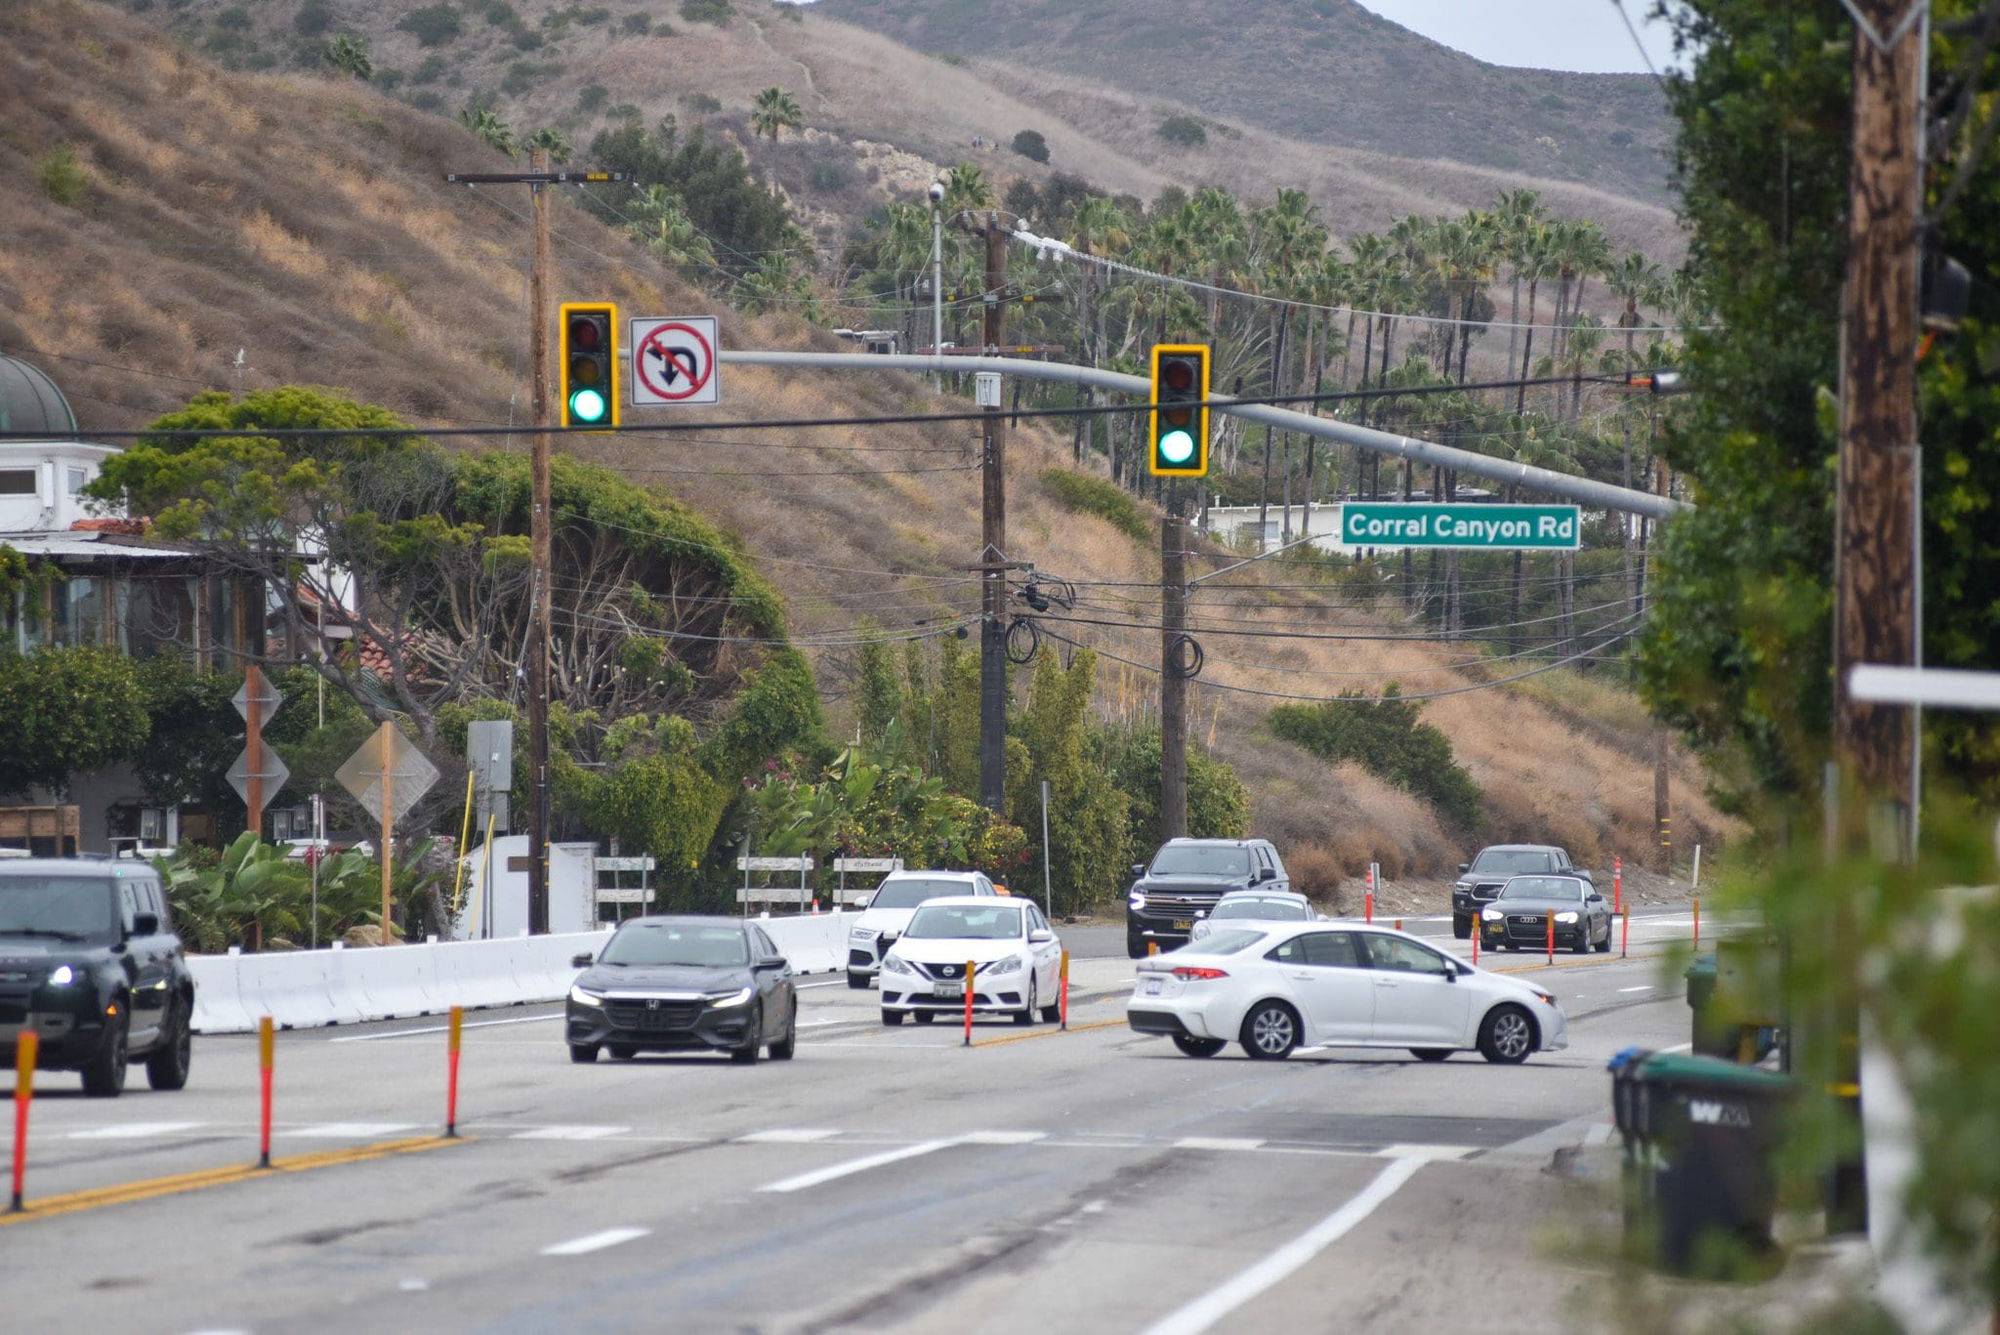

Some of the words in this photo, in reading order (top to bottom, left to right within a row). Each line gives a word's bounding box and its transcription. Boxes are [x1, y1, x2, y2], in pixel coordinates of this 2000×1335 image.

[1349, 513, 1427, 536] Corral
[1434, 514, 1531, 543] Canyon
[1539, 515, 1573, 538] Rd
